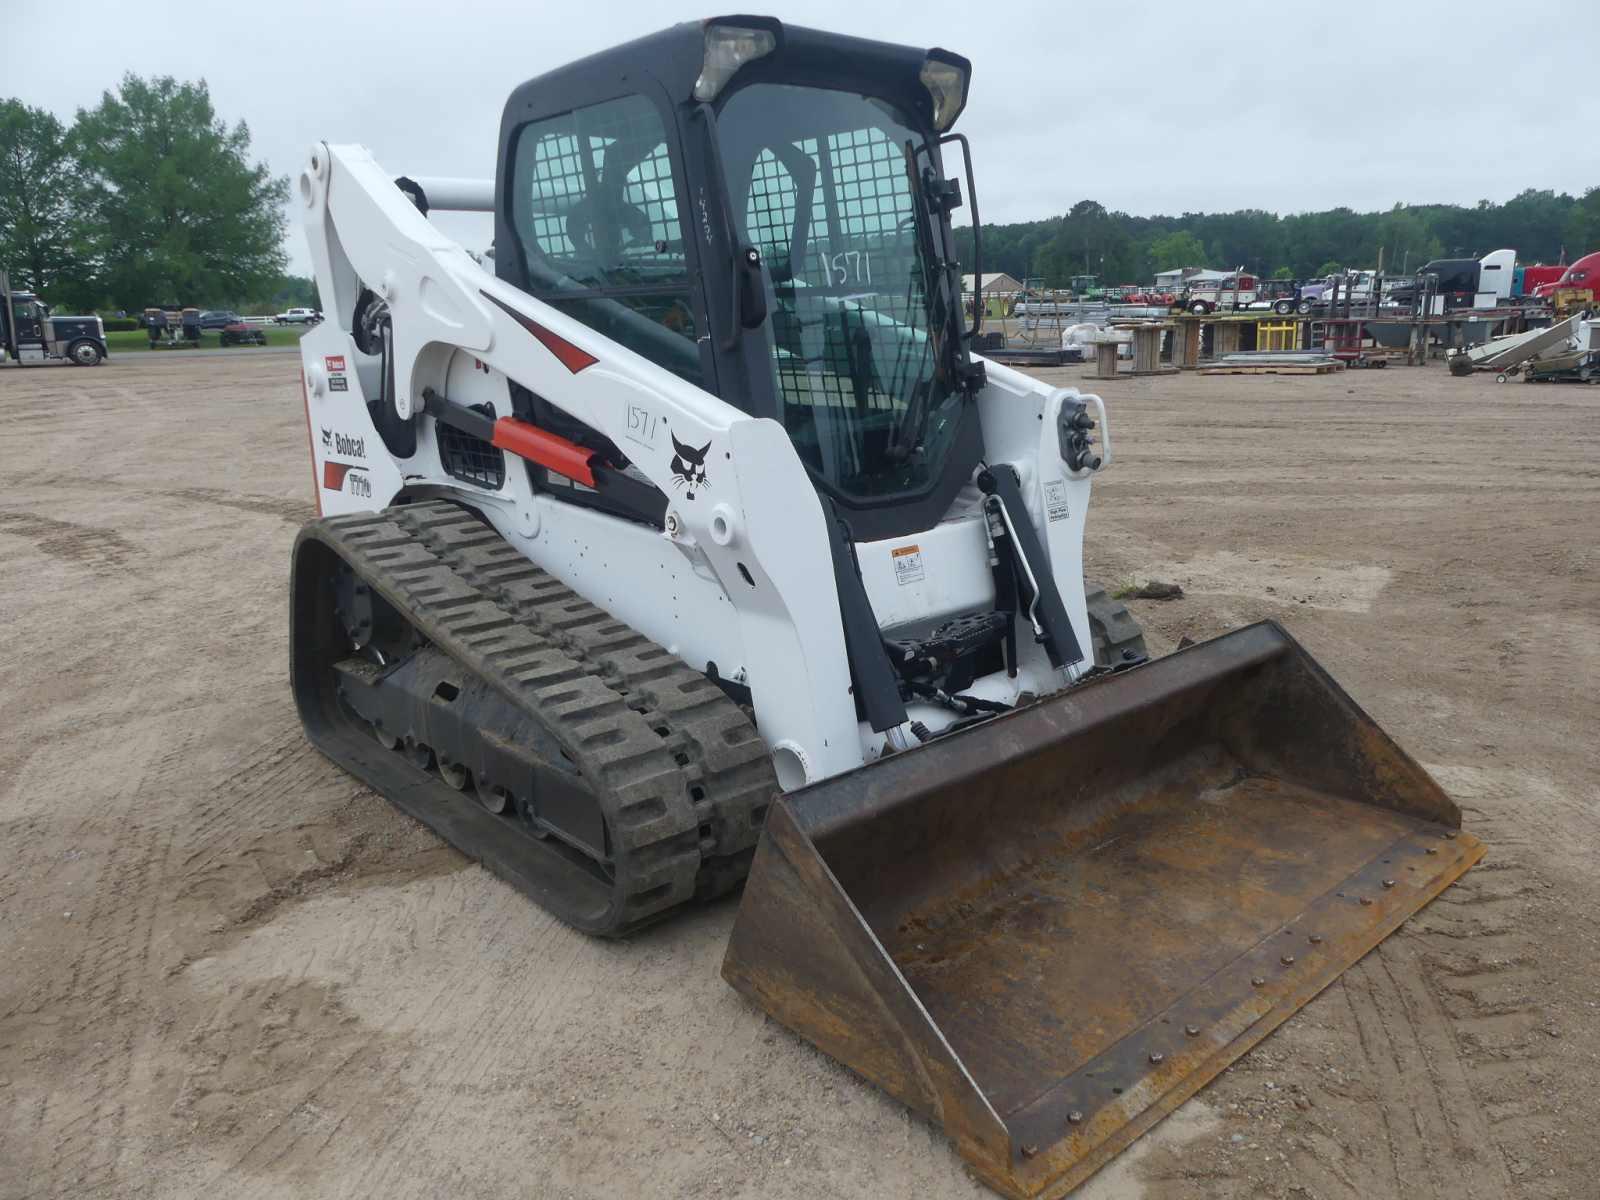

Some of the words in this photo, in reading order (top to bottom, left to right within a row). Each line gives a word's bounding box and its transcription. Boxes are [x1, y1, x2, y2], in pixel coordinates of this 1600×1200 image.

[821, 250, 872, 288] 1571
[626, 401, 657, 440] 1571
[335, 432, 367, 458] Bobcat
